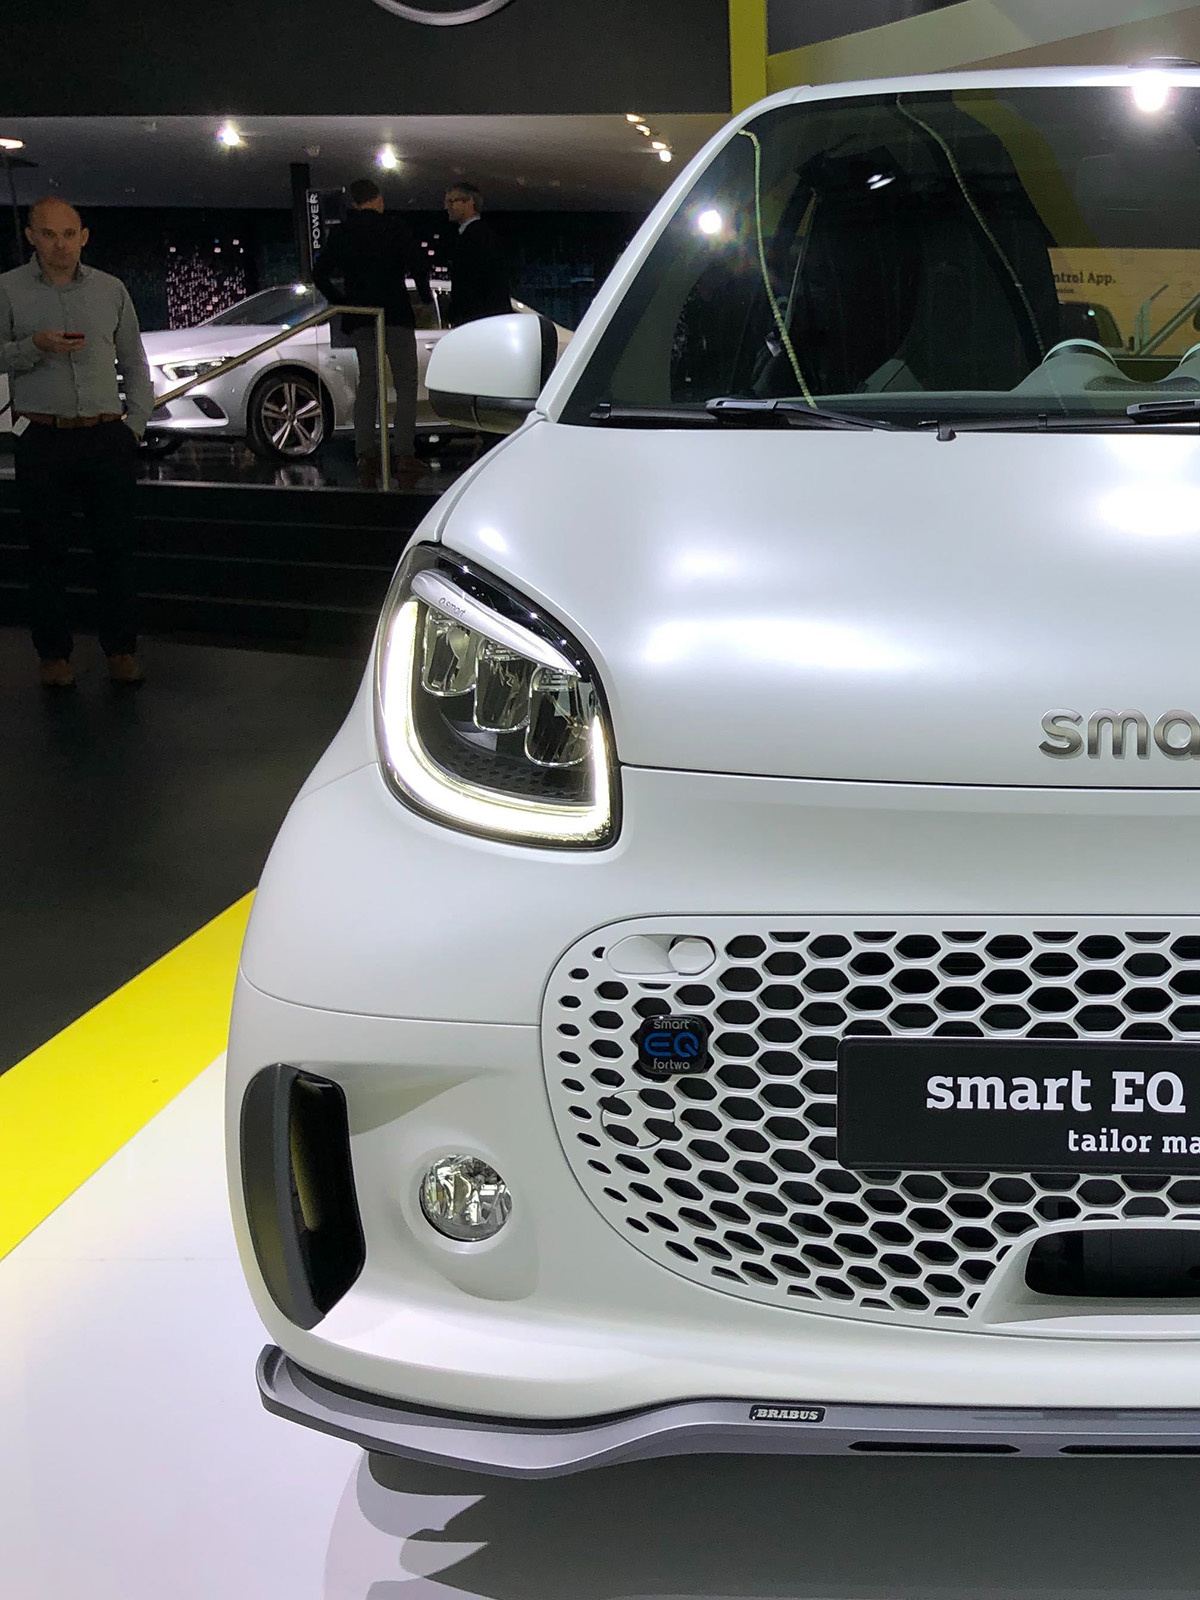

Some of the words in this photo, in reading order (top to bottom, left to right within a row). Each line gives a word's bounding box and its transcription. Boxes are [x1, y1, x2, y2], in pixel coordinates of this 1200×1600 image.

[309, 193, 320, 249] POWER
[1087, 271, 1117, 287] App.
[653, 1019, 690, 1030] smart
[644, 1032, 699, 1058] EQ
[652, 1057, 691, 1070] fortwo
[925, 1069, 1093, 1113] smart
[1110, 1070, 1187, 1114] EQ
[1067, 1128, 1151, 1154] tailor
[756, 1408, 819, 1421] BRABUS
